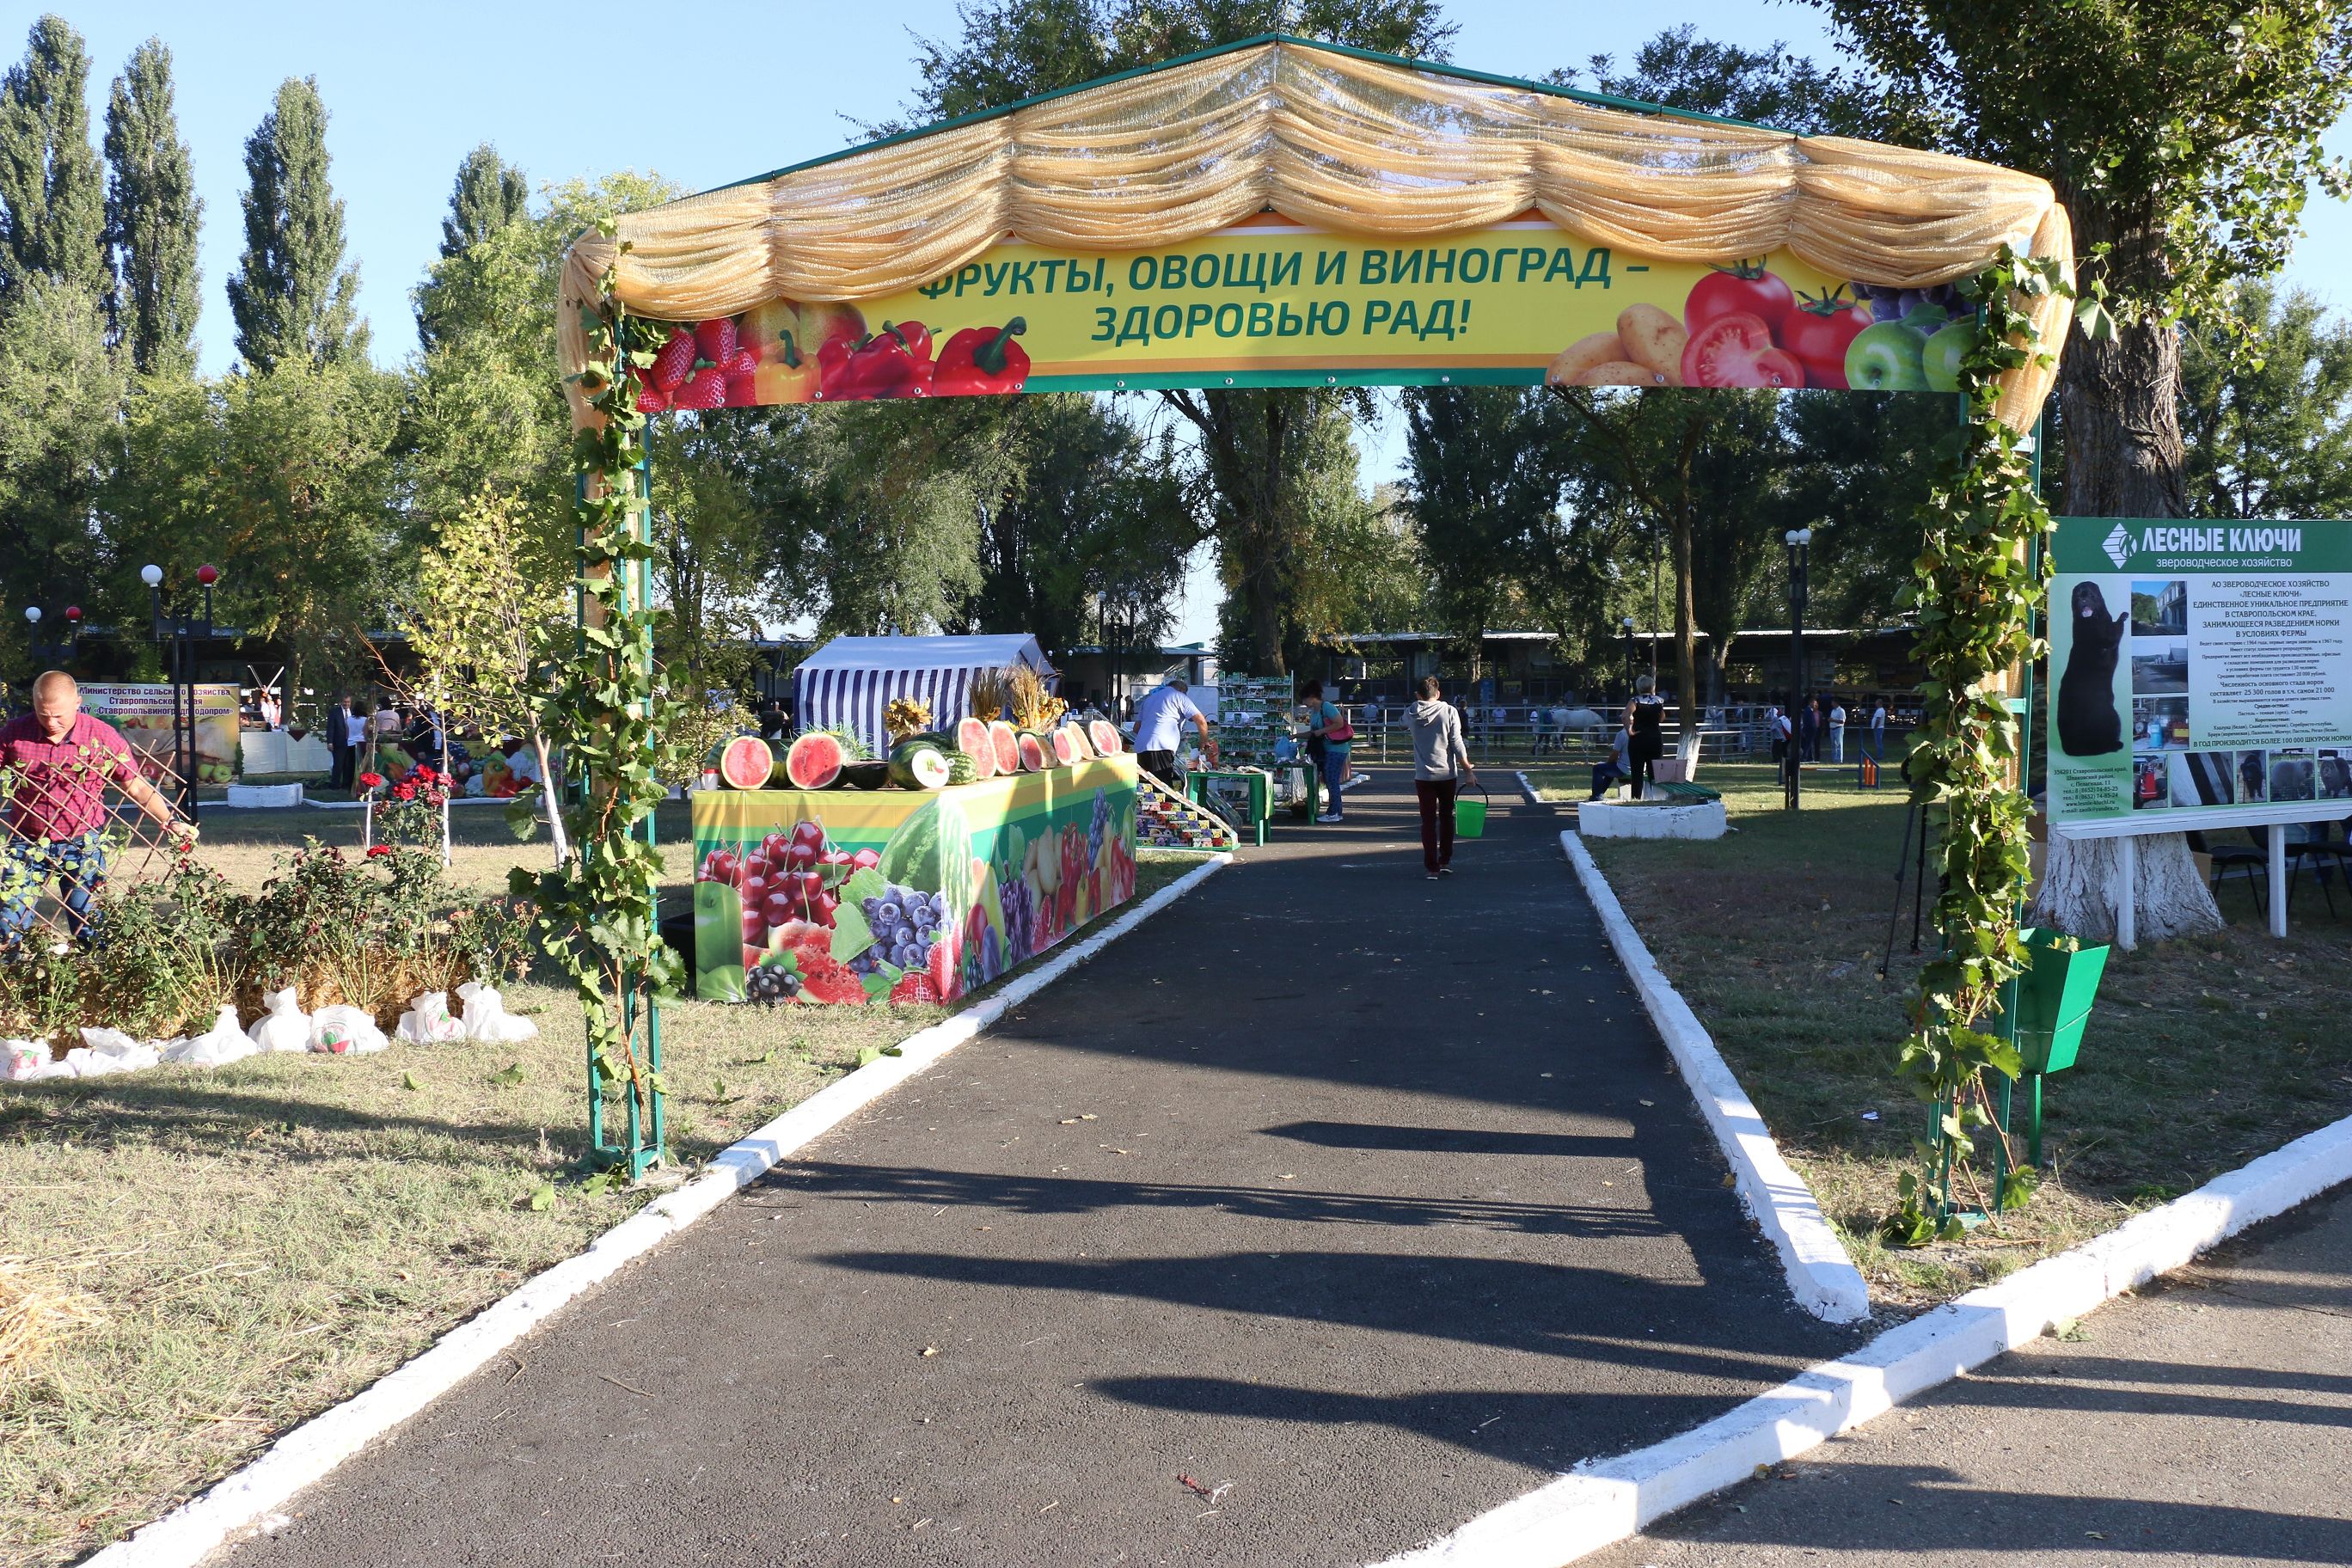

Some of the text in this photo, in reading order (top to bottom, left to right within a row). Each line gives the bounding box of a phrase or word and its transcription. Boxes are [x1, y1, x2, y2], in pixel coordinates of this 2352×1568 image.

[918, 257, 1114, 299] ФРУКТЫ,
[1129, 250, 1302, 294] ОВОЩИ
[1314, 249, 1347, 286] И
[1358, 247, 1612, 290] ВИНОГРАД
[1091, 298, 1472, 347] ЗДОРОВЬЮ РАД!
[2141, 527, 2301, 552] ЛЕСНЫЕ КЛЮЧИ
[2156, 556, 2293, 569] звероводческое хозяйство
[2299, 599, 2349, 608] ПРЕДПРИЯТИЕ
[79, 686, 230, 695] Министерство сельско озяйства
[109, 696, 180, 707] Ставропольско
